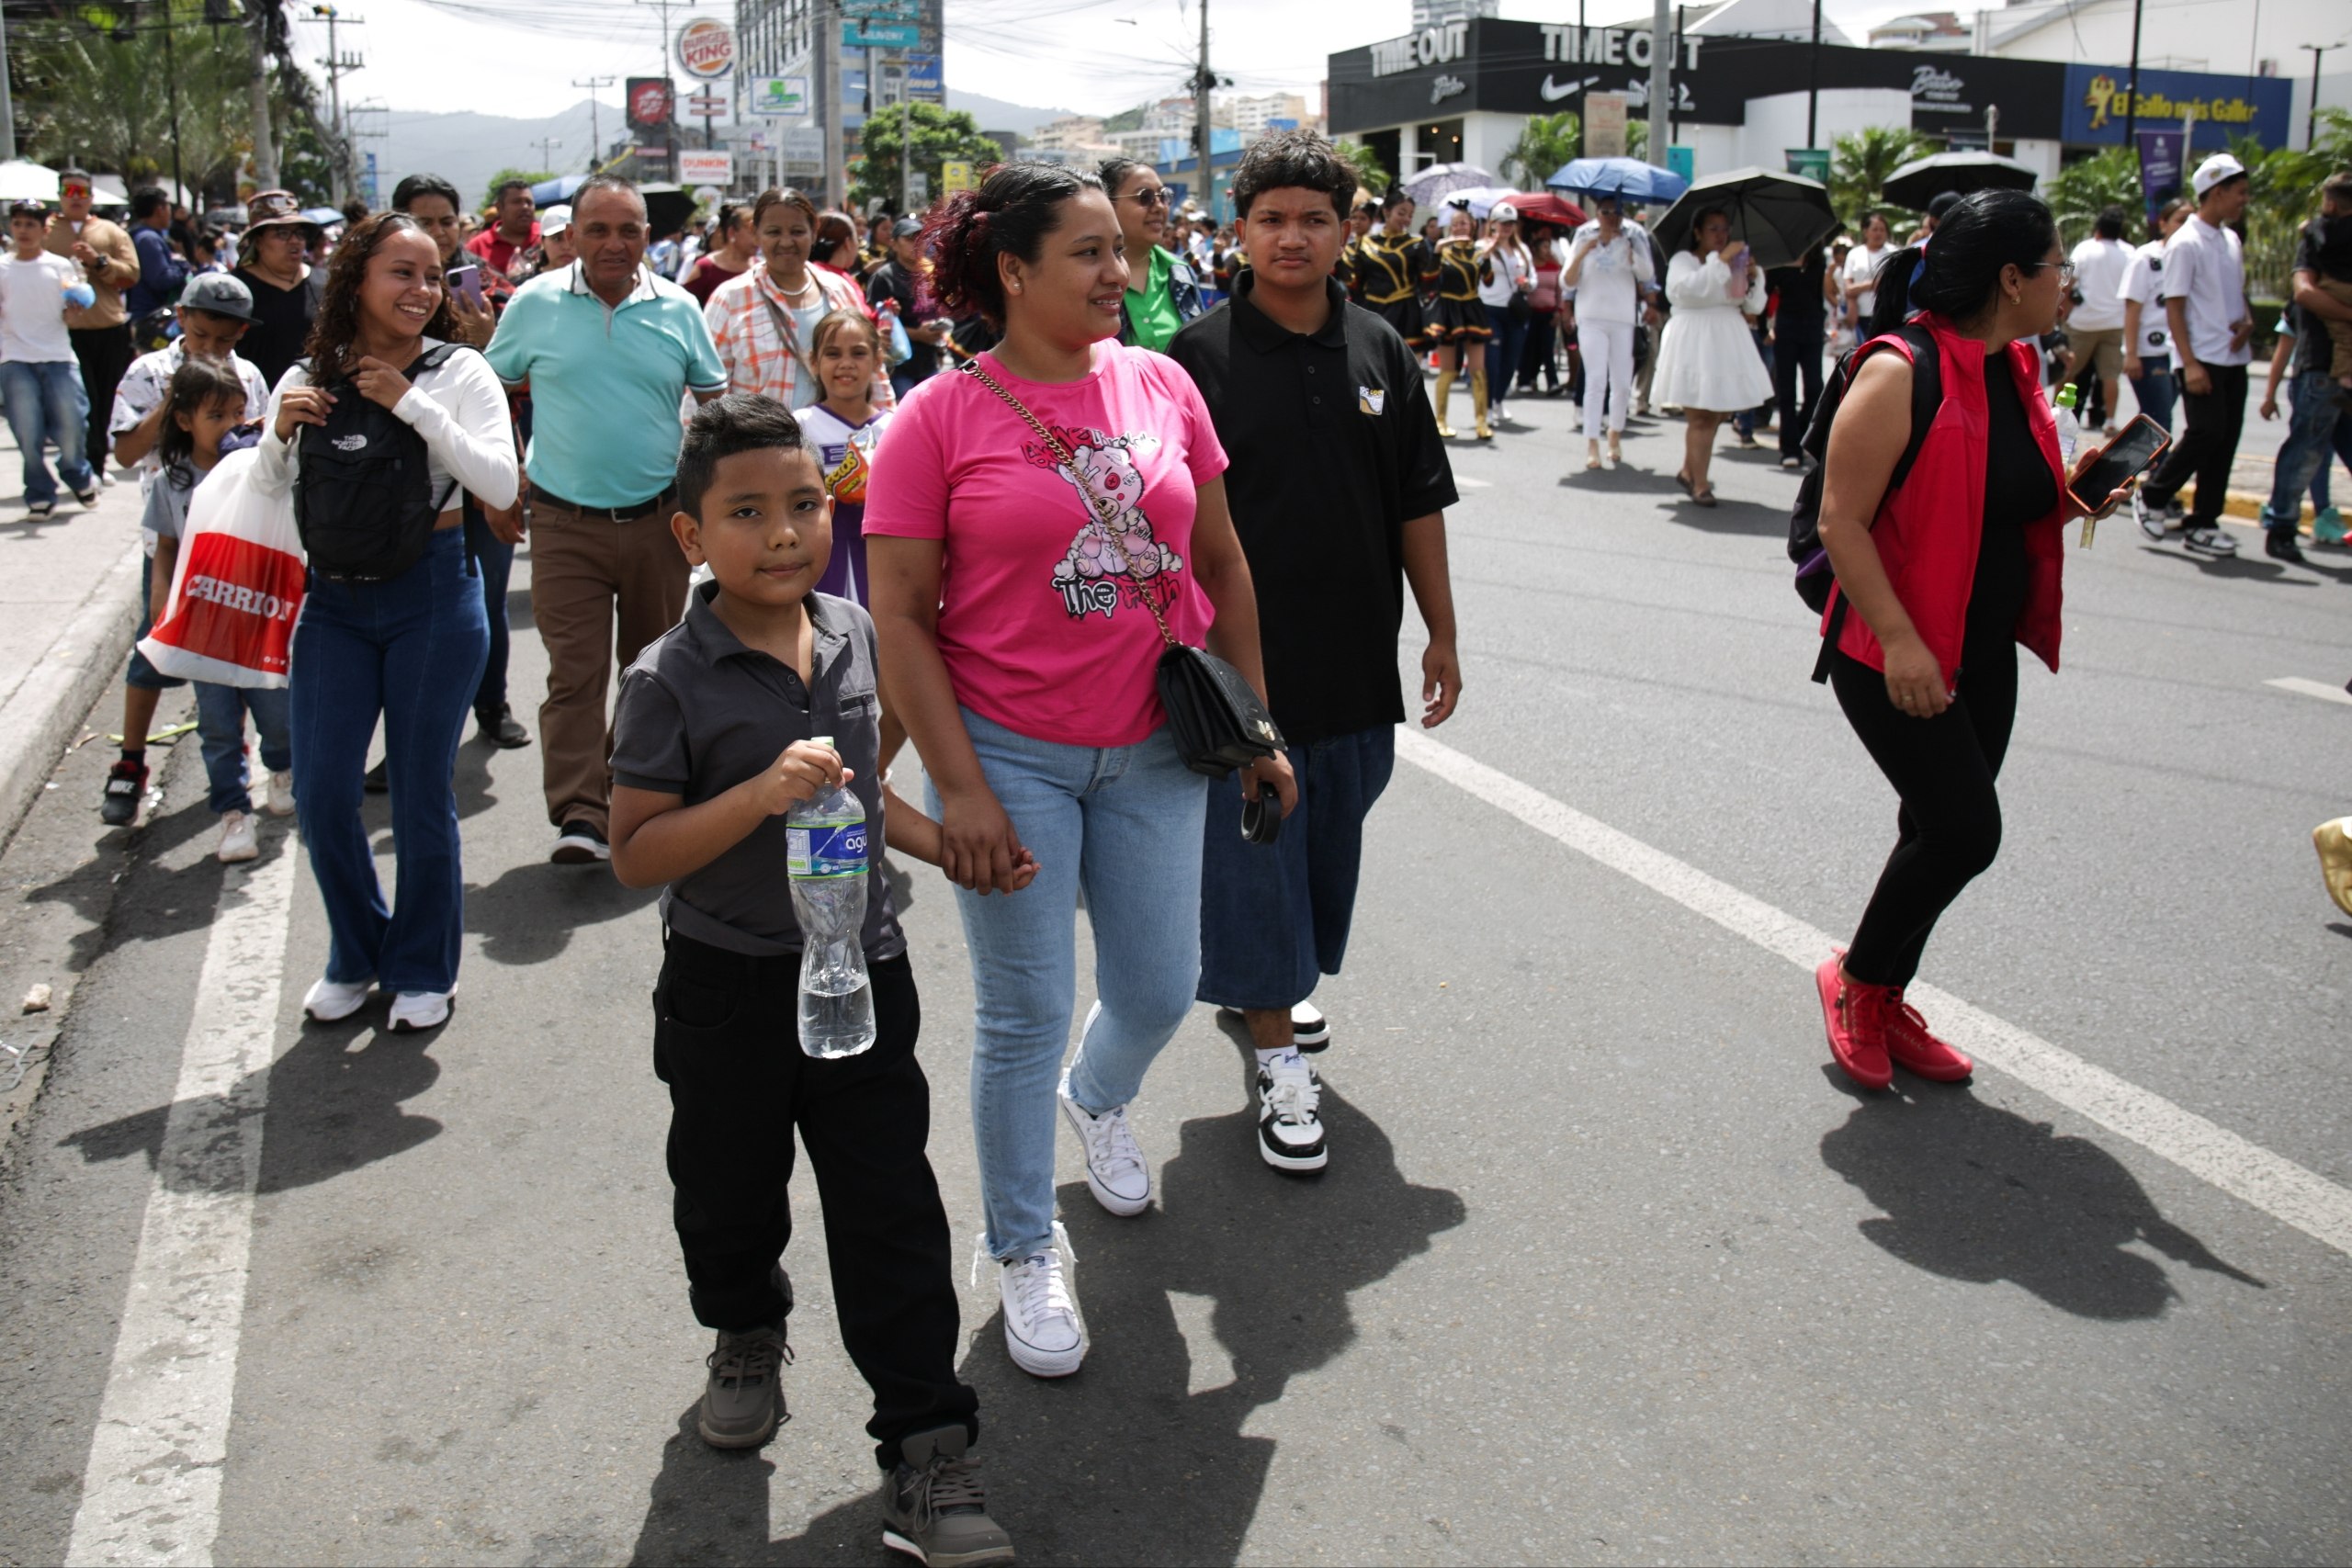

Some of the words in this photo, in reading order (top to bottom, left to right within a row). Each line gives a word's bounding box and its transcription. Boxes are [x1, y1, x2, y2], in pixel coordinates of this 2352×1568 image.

[683, 31, 729, 52] BURGER
[685, 42, 731, 67] KING
[186, 574, 295, 622] CARRION
[1051, 576, 1117, 620] The
